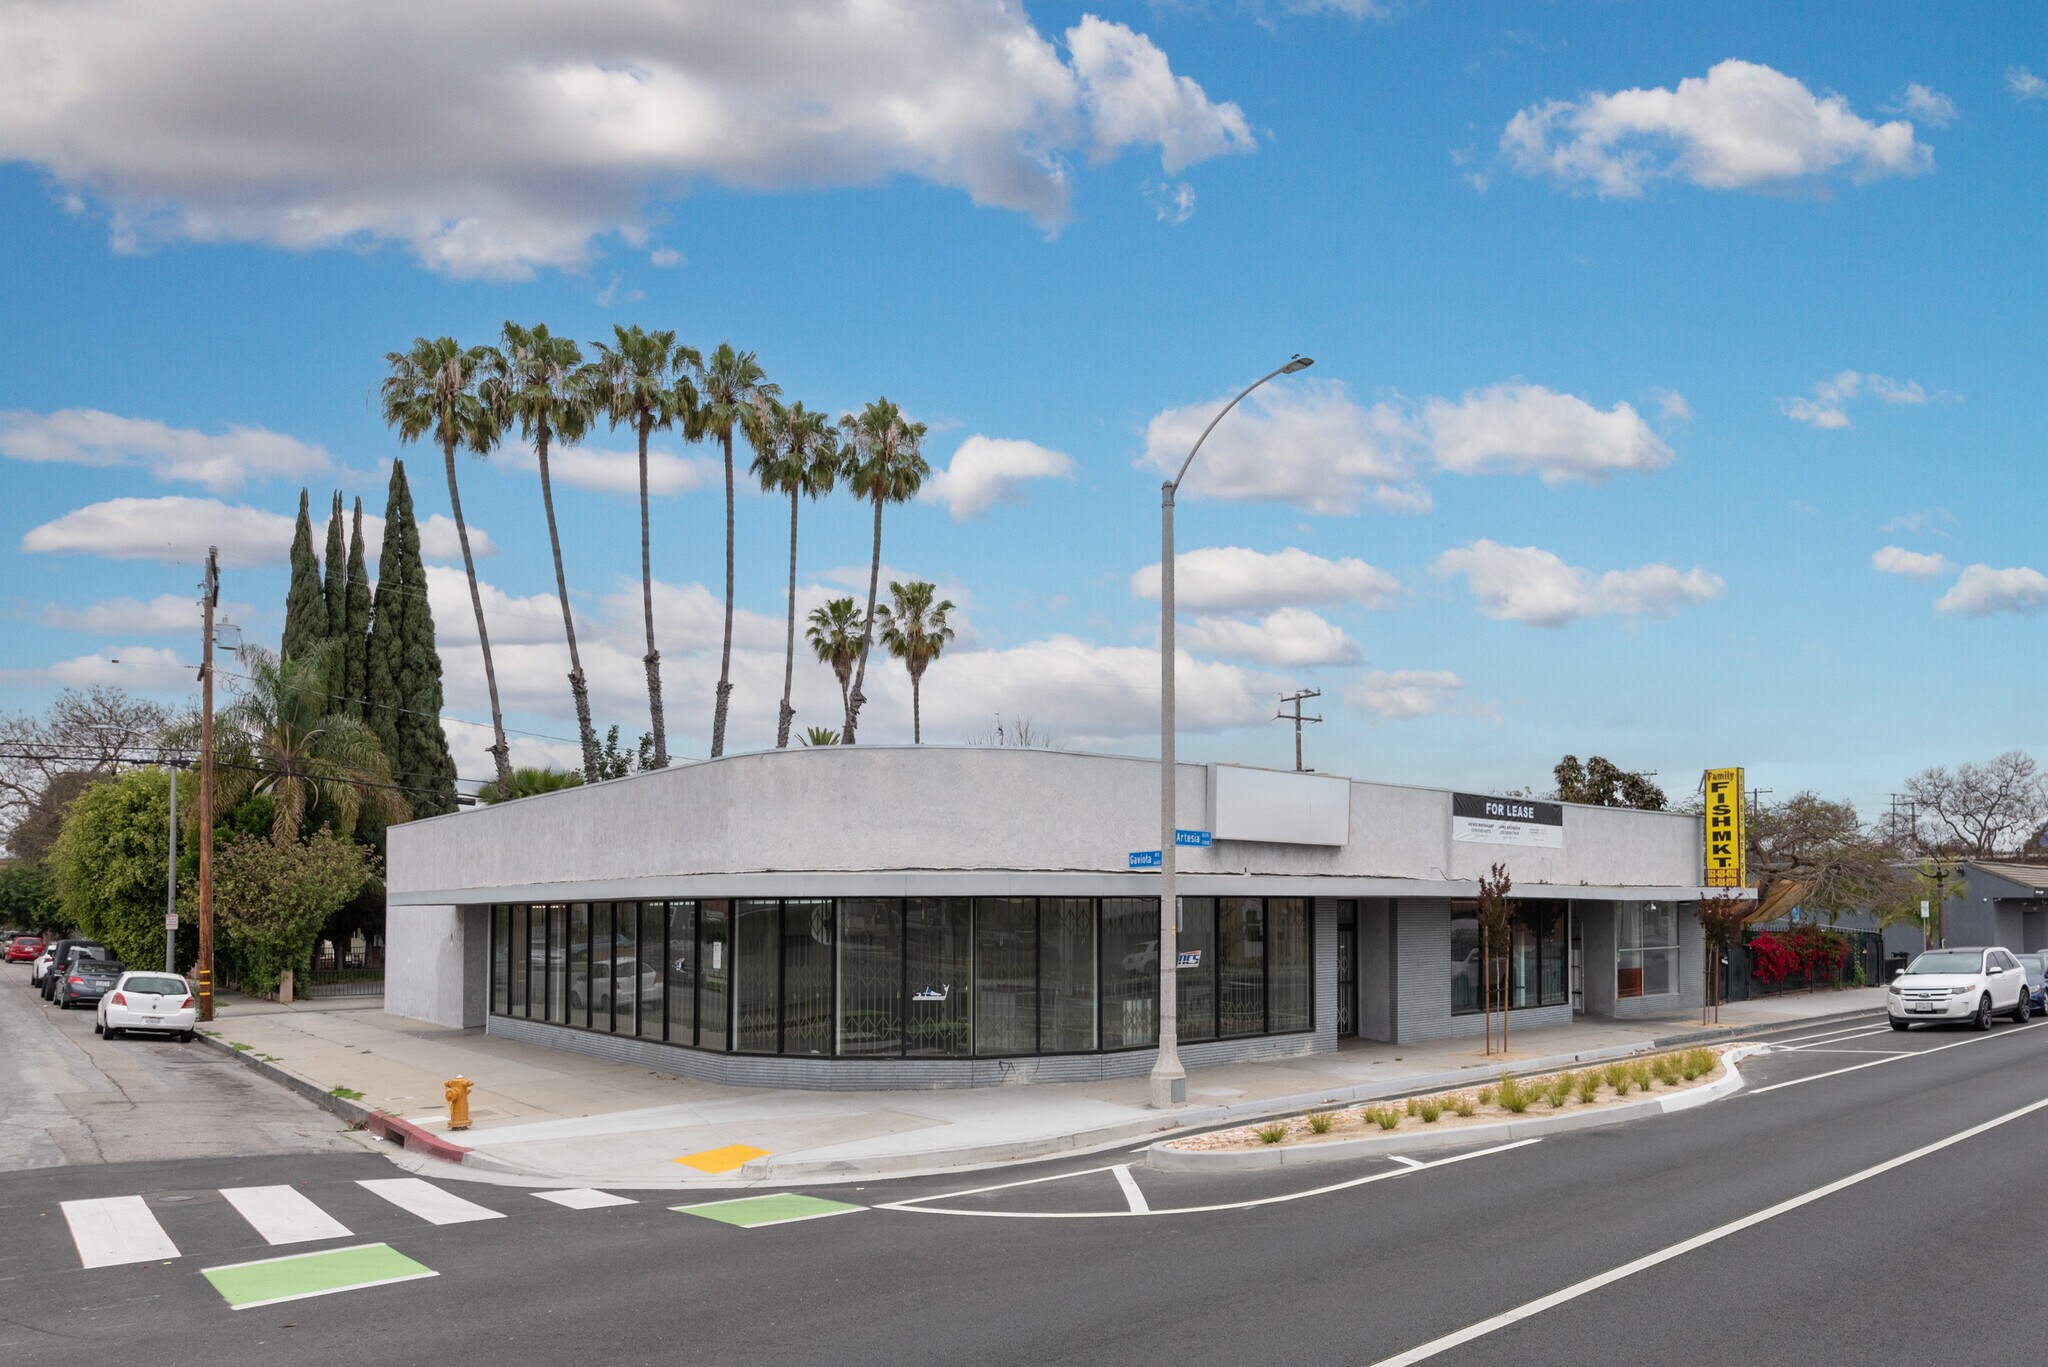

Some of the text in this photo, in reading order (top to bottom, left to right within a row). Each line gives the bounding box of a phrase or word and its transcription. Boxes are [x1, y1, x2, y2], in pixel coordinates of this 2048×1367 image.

[1707, 770, 1735, 781] Family
[1486, 802, 1534, 818] FOR LEASE
[1176, 832, 1200, 843] Artesia
[1130, 854, 1152, 865] Gaviota
